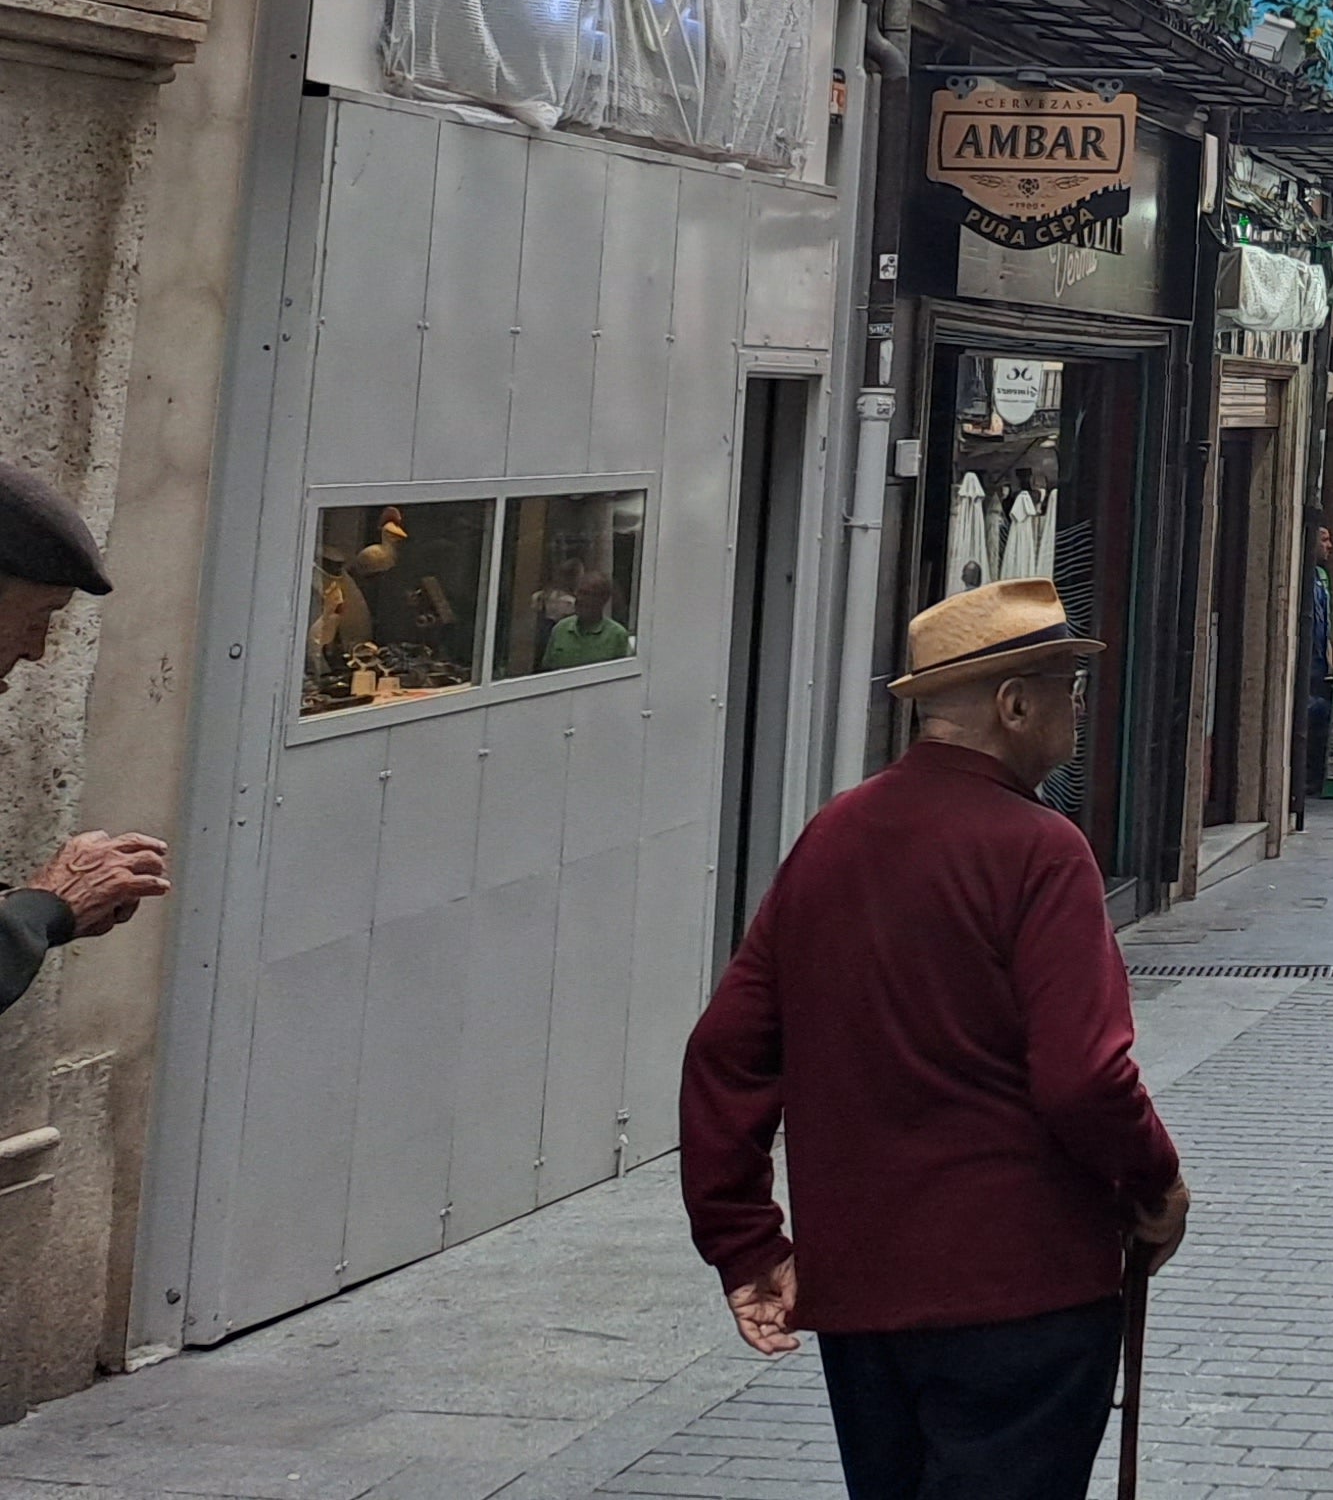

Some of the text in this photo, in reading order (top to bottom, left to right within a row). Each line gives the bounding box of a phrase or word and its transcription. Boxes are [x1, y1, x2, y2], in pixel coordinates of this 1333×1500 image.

[984, 98, 1083, 110] CERVEZAS
[954, 123, 1109, 161] AMBAR
[965, 208, 1026, 246] PURA
[1036, 207, 1095, 243] CEPA
